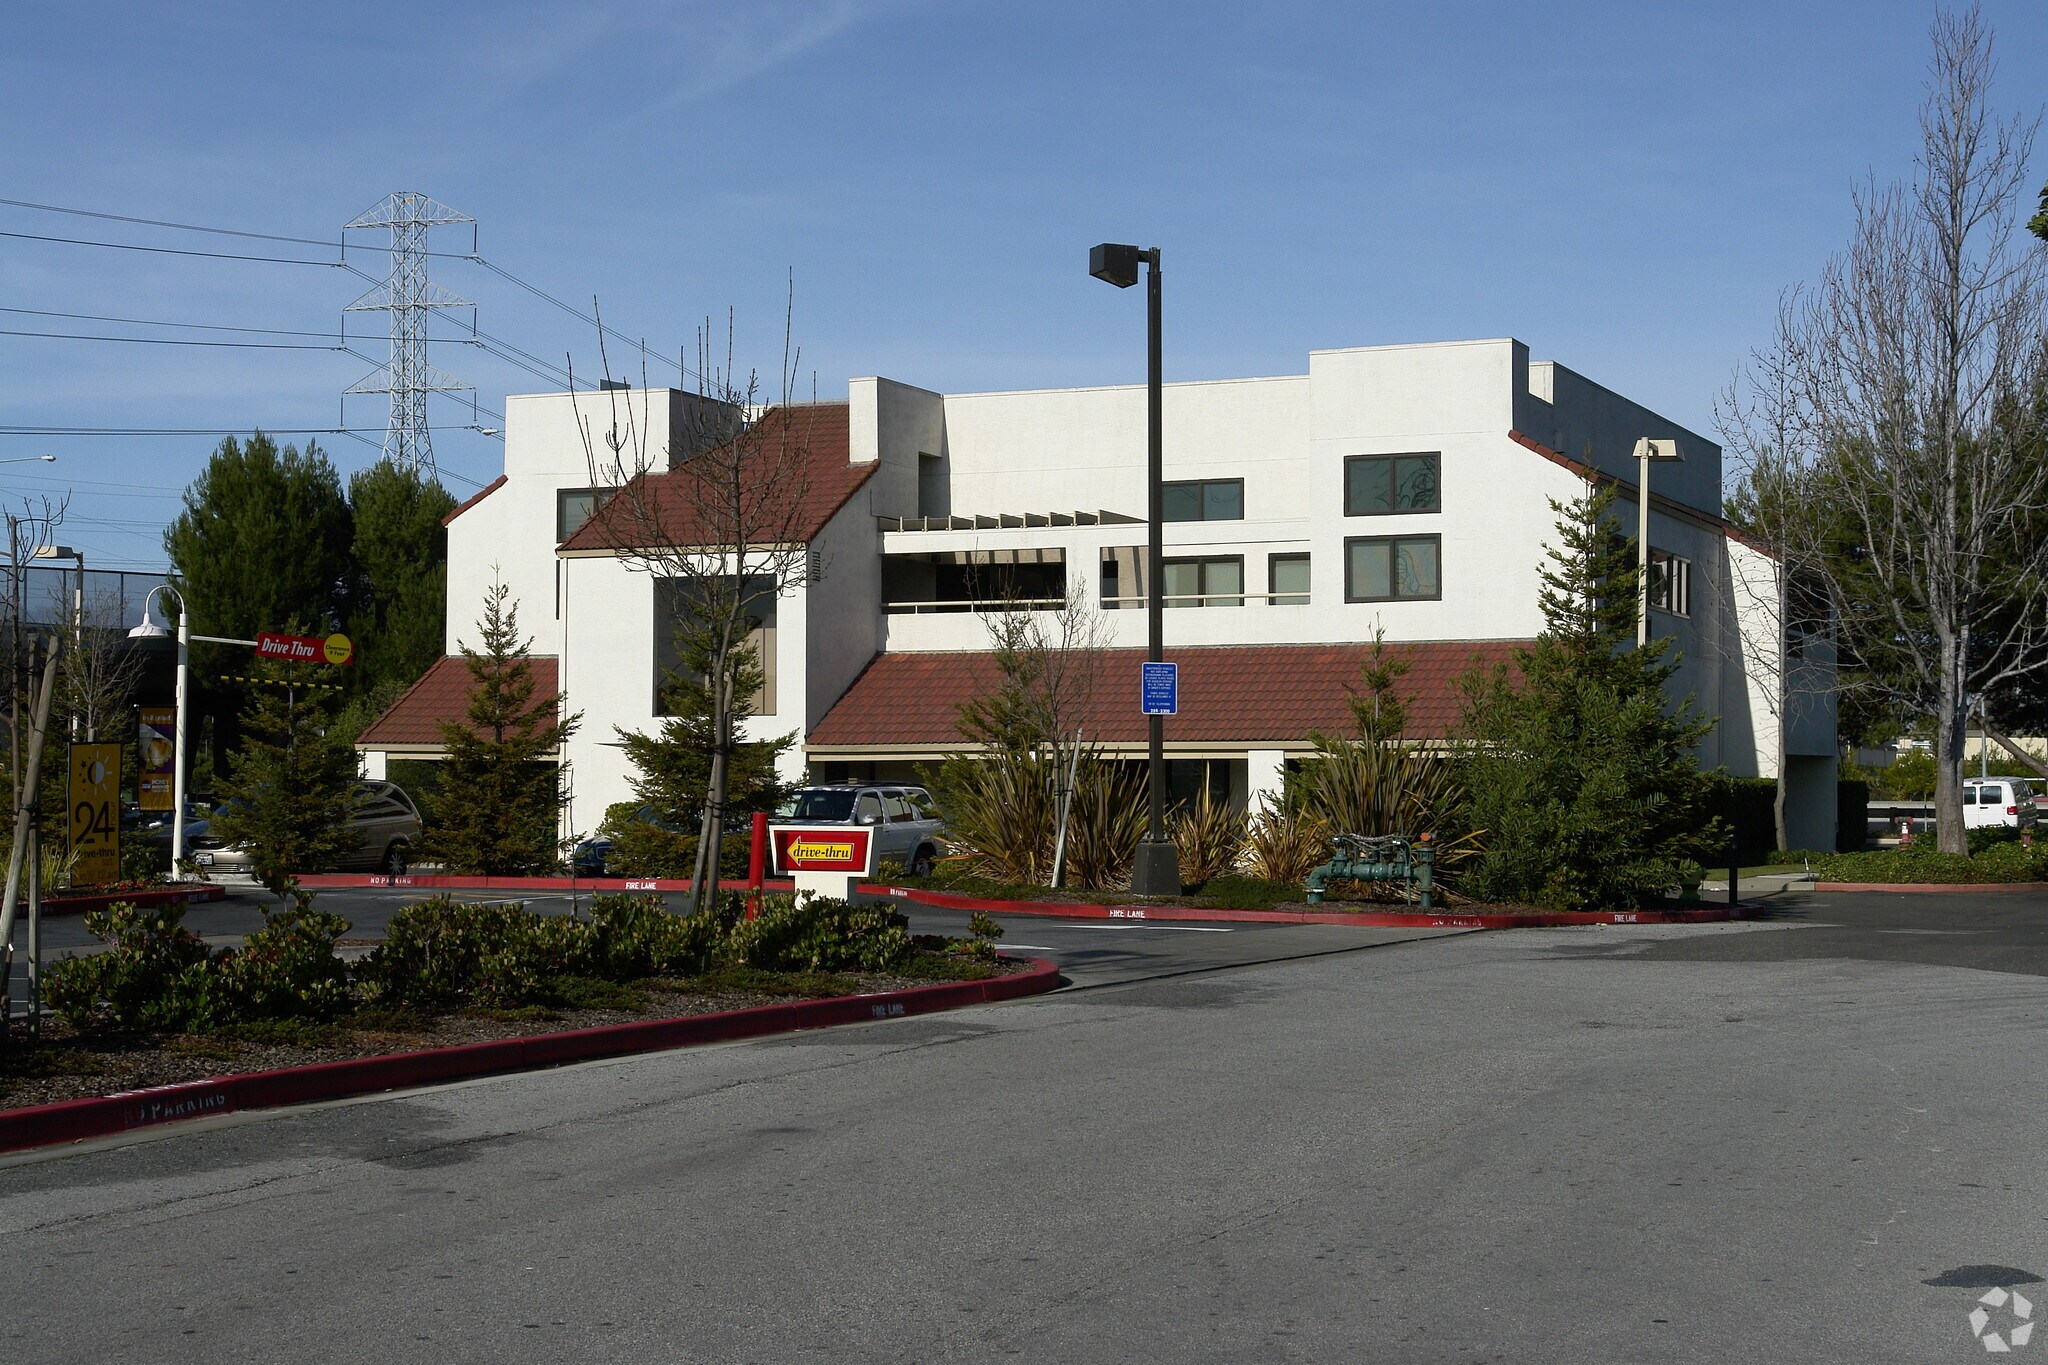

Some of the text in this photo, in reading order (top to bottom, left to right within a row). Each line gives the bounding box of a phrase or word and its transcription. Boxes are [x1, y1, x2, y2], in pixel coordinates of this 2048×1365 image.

[261, 637, 315, 657] Drive Thru
[75, 801, 115, 845] 24
[77, 848, 115, 858] ive-thru
[793, 845, 850, 858] drive-thru
[625, 881, 657, 890] FIRE LANE
[1110, 909, 1146, 919] FIRE LANE
[1614, 914, 1625, 922] FIRE
[151, 1093, 226, 1120] PARKING
